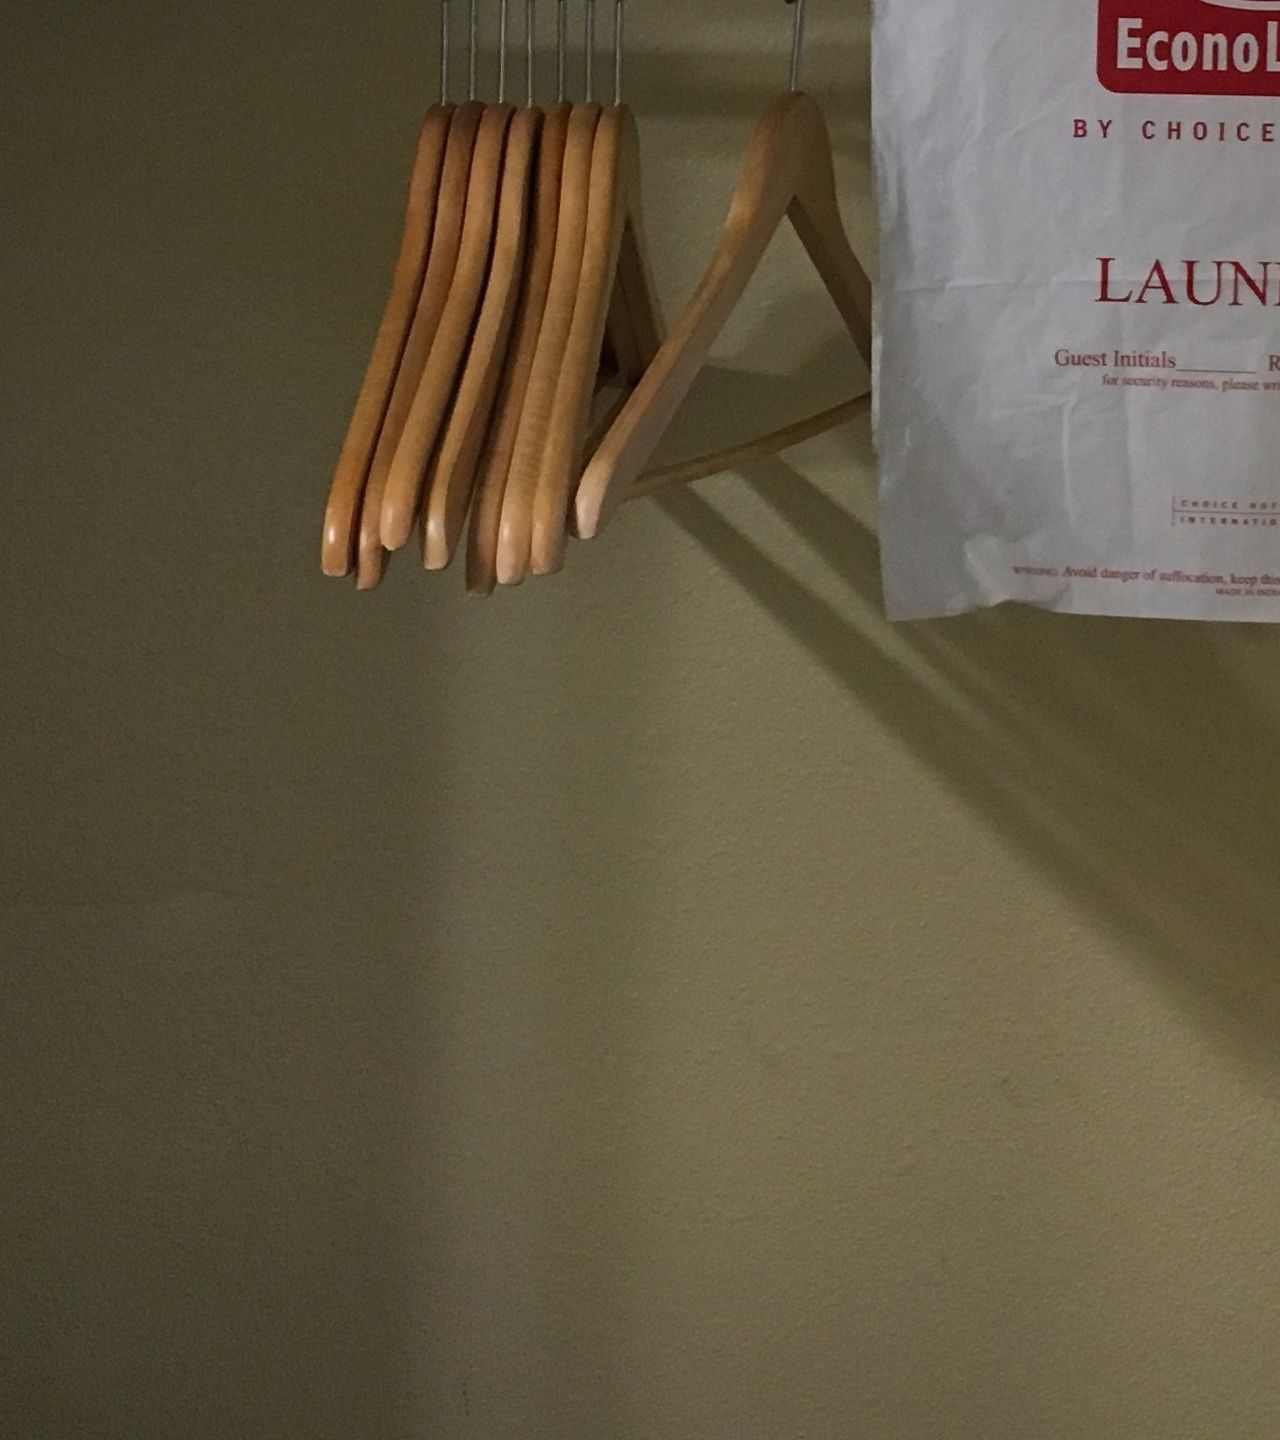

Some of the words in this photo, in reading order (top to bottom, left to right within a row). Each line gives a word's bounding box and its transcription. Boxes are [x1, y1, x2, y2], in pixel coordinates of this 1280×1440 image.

[1072, 119, 1113, 139] BY
[1141, 120, 1276, 143] CHOICE
[1054, 348, 1108, 367] Guest
[1113, 349, 1177, 369] Initials
[1102, 374, 1119, 386] for
[1122, 375, 1168, 390] security
[1222, 377, 1260, 392] please
[1180, 499, 1239, 510] CHOICE
[1063, 565, 1098, 579] Avoid
[1100, 566, 1141, 583] danger
[1142, 568, 1158, 581] of
[1230, 572, 1258, 587] keep
